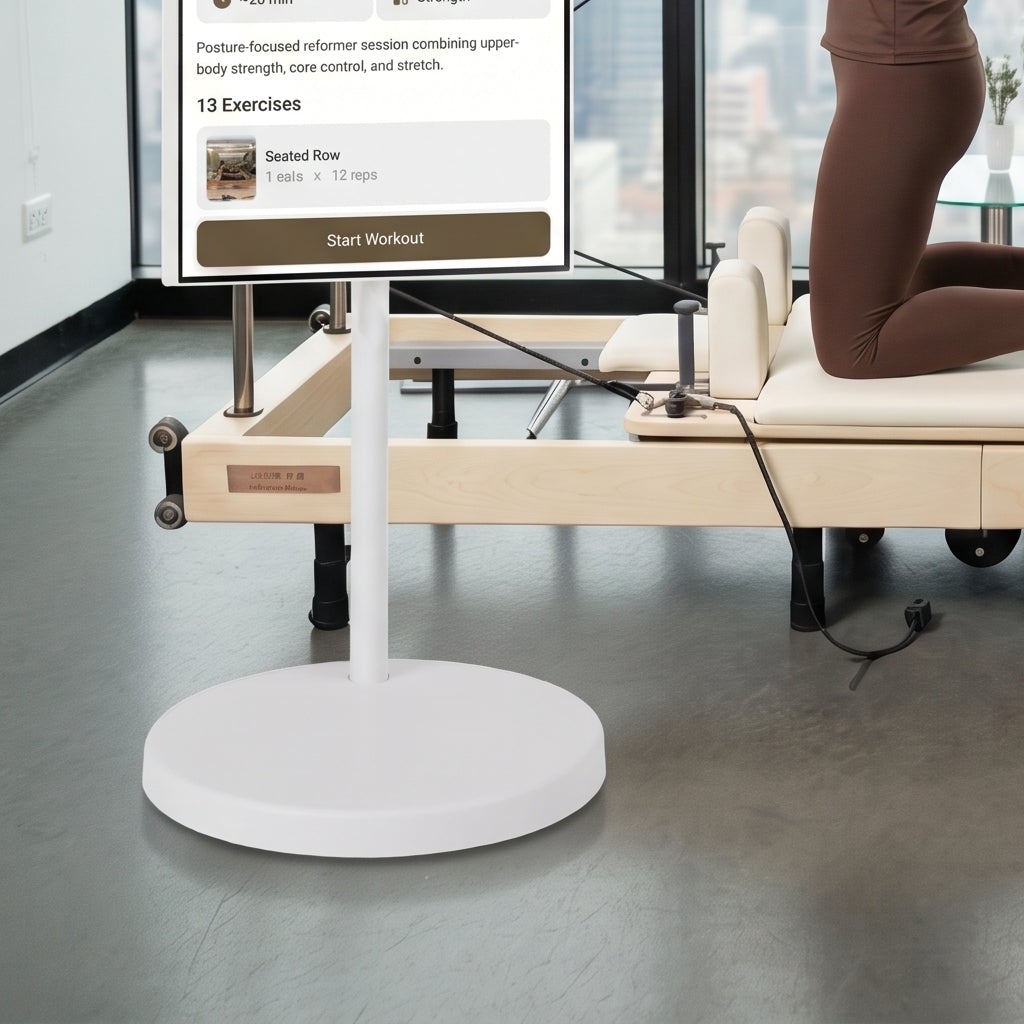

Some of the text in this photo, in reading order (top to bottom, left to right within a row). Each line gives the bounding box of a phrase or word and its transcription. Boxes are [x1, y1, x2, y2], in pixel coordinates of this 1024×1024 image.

[196, 36, 520, 54] Posture-focused reformer session combining upper-
[196, 57, 444, 78] body strength, core control, and stretch.
[196, 95, 302, 113] 13 Exercises
[265, 148, 341, 163] Seated Row
[332, 168, 348, 182] 12
[350, 170, 378, 185] reps
[326, 231, 425, 248] Start Workout
